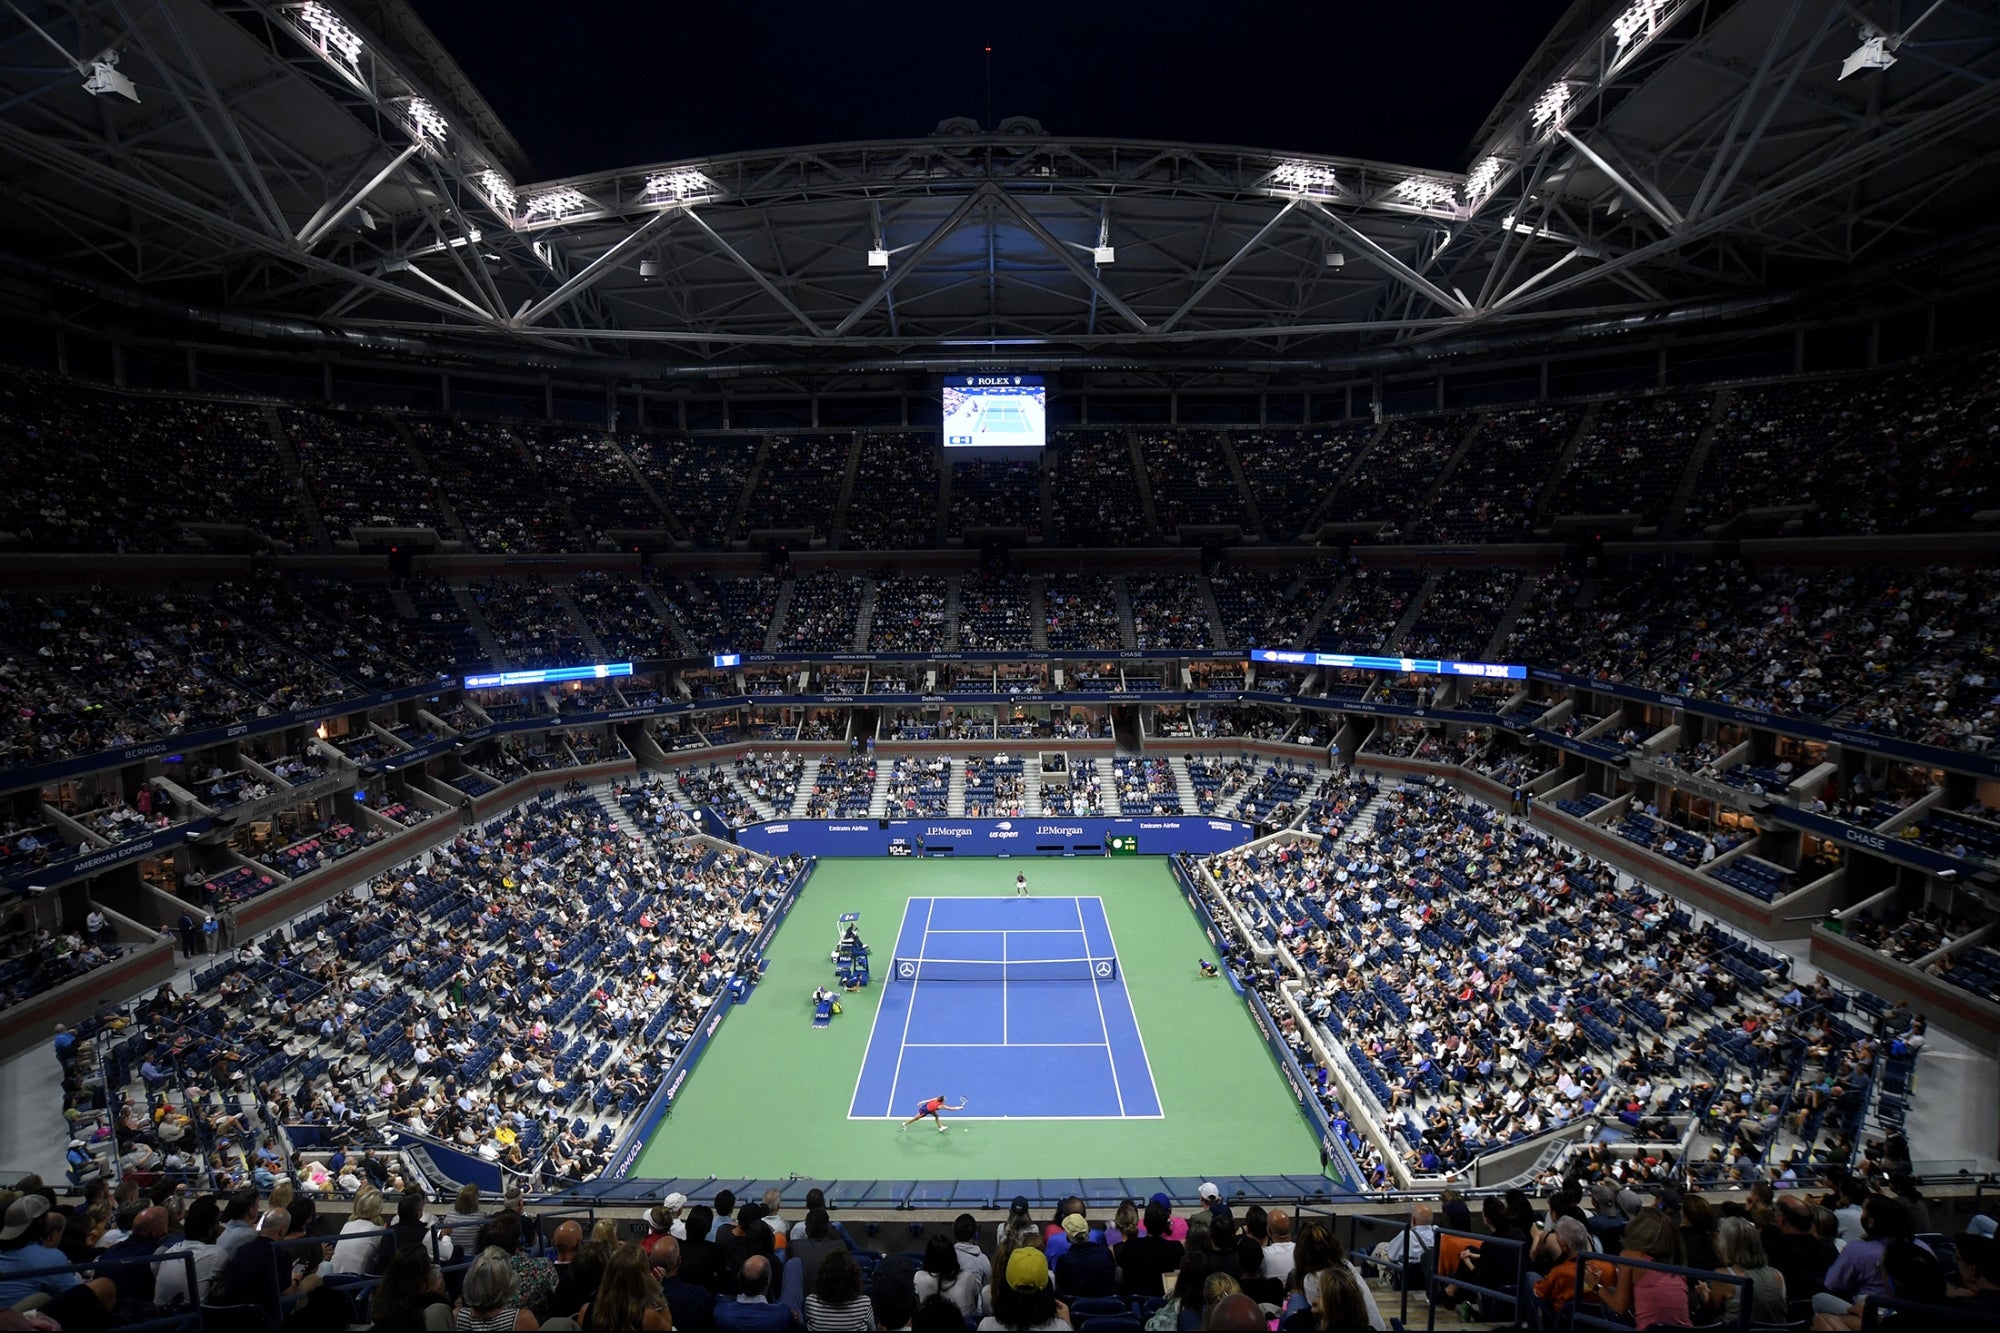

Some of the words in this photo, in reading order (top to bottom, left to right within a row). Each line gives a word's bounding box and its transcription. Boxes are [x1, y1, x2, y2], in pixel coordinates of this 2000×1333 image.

[1734, 711, 1768, 724] CHUBB
[227, 725, 248, 737] ESPN
[125, 744, 168, 759] BERMUDA
[925, 826, 972, 838] J.P.Morgan
[1036, 826, 1083, 837] J.P.Morgan
[1846, 828, 1886, 851] CHASE
[73, 852, 117, 873] AMERICAN
[118, 840, 154, 858] EXPRESS
[667, 1069, 687, 1100] Spectrum
[1282, 1061, 1304, 1102] CHUBB
[613, 1140, 642, 1179] ERMUDA
